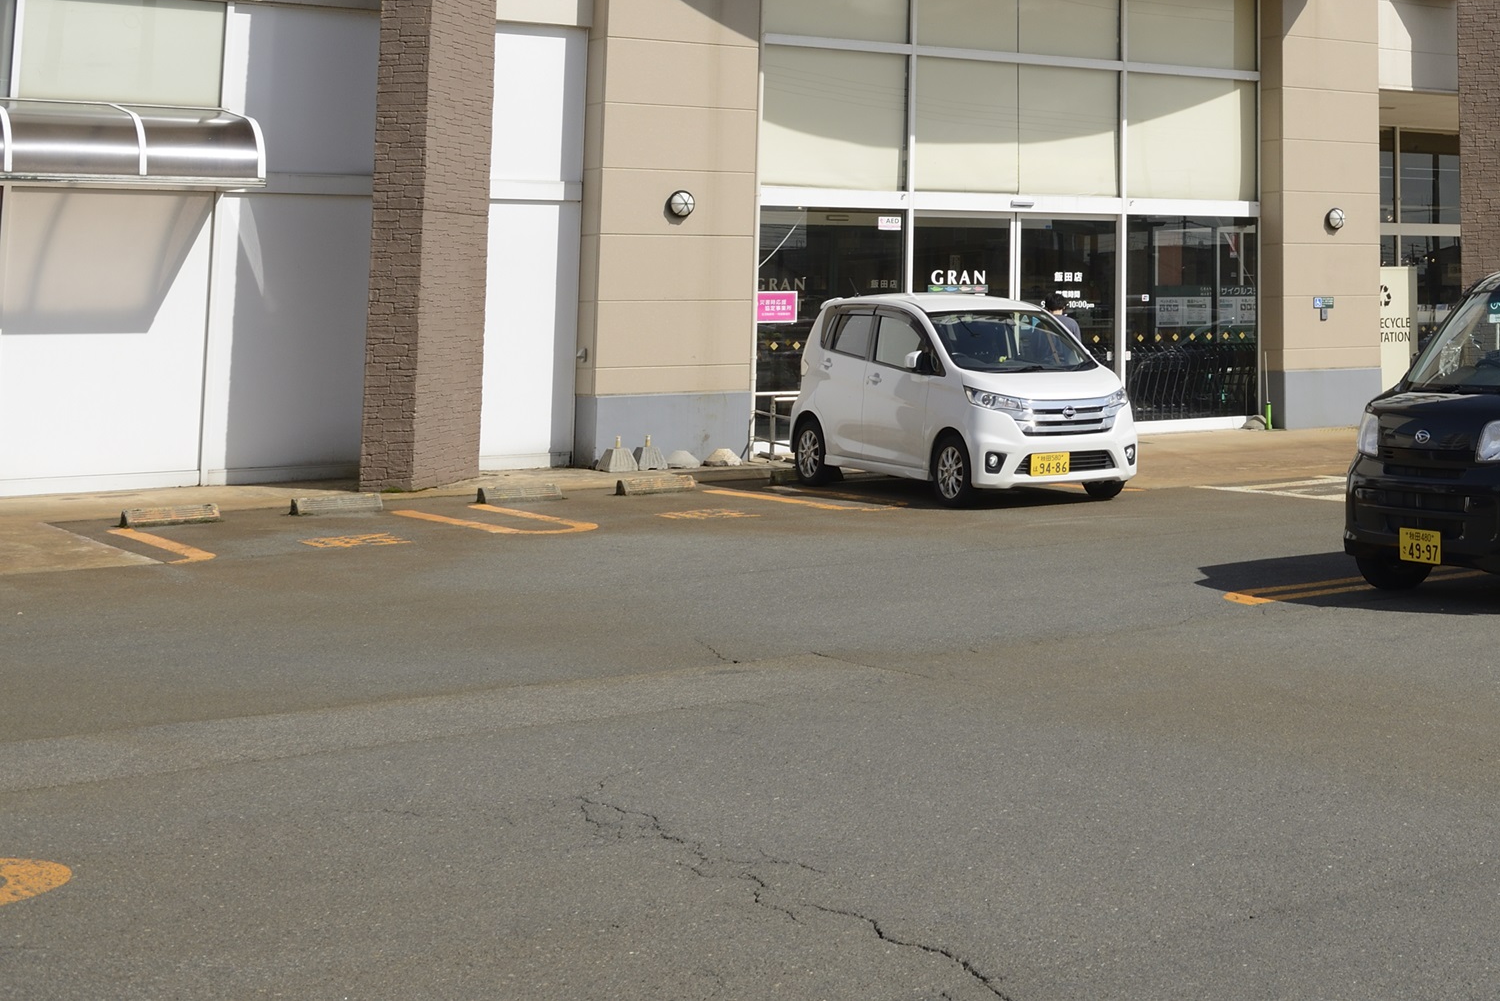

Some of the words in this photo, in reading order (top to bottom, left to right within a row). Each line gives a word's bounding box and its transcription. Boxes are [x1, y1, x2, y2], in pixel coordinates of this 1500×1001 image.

[930, 270, 986, 285] GRAN
[1053, 271, 1083, 283] 飯田店
[757, 277, 807, 291] GRAN
[1380, 318, 1410, 329] ECYCLE
[1380, 332, 1410, 342] TATION
[1039, 461, 1067, 474] 94-86
[1408, 542, 1438, 561] 49-97
